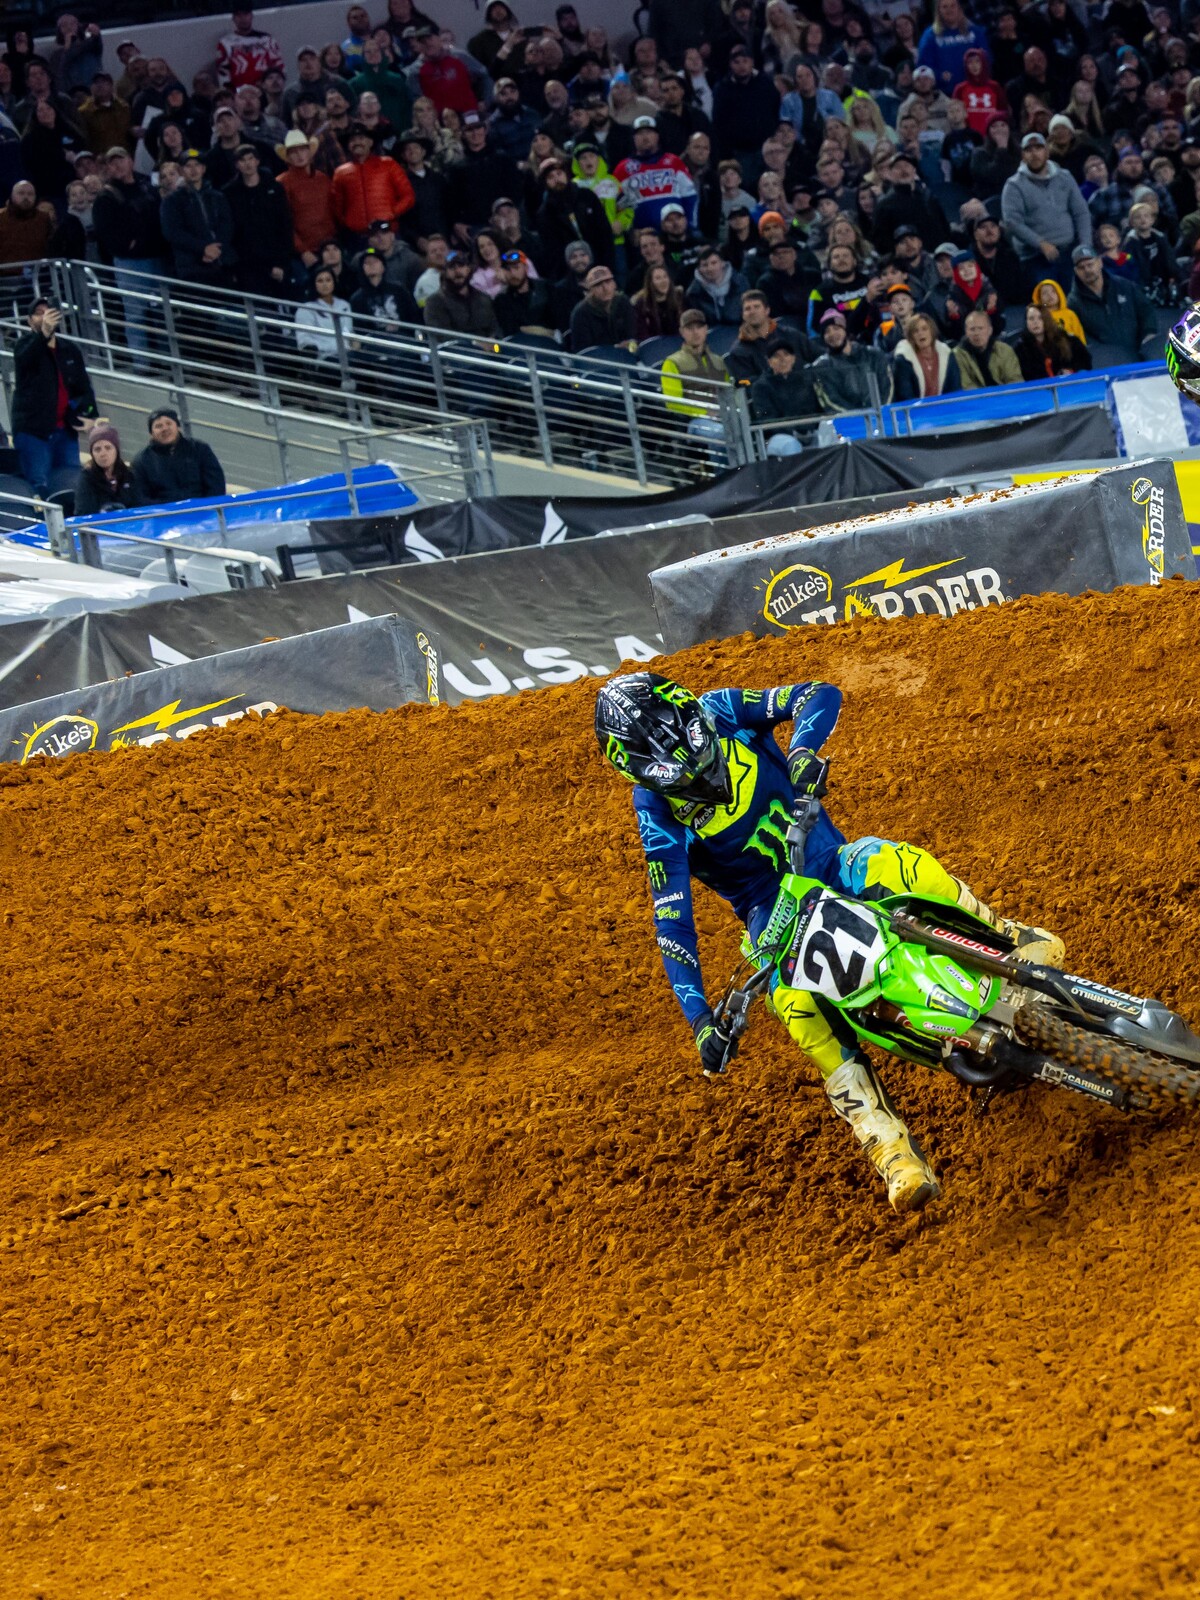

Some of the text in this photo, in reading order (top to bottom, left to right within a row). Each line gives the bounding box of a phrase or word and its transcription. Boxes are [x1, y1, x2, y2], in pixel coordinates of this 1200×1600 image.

[1147, 486, 1165, 586] HARDER
[769, 574, 829, 619] mike's
[693, 806, 715, 830] Airoh
[803, 893, 879, 999] 21
[1071, 987, 1119, 1008] CARRILLO
[1067, 1074, 1114, 1097] CARRILLO
